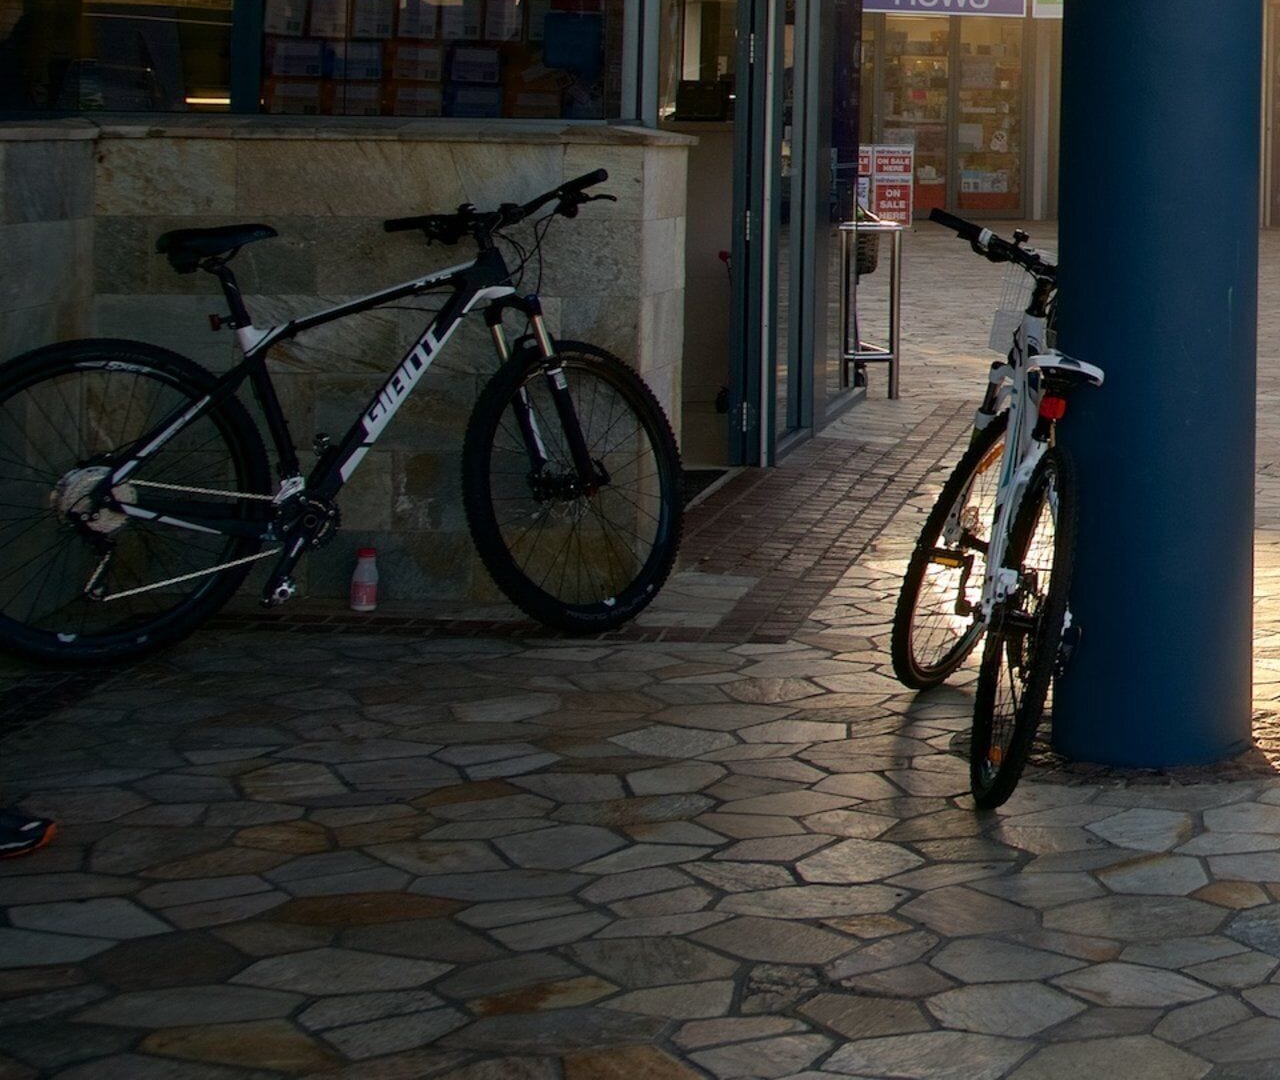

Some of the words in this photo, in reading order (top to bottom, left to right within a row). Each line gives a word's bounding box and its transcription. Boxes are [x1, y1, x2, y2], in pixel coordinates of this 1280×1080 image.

[885, 189, 901, 198] ON
[879, 200, 906, 209] SALE
[878, 211, 907, 220] HERE
